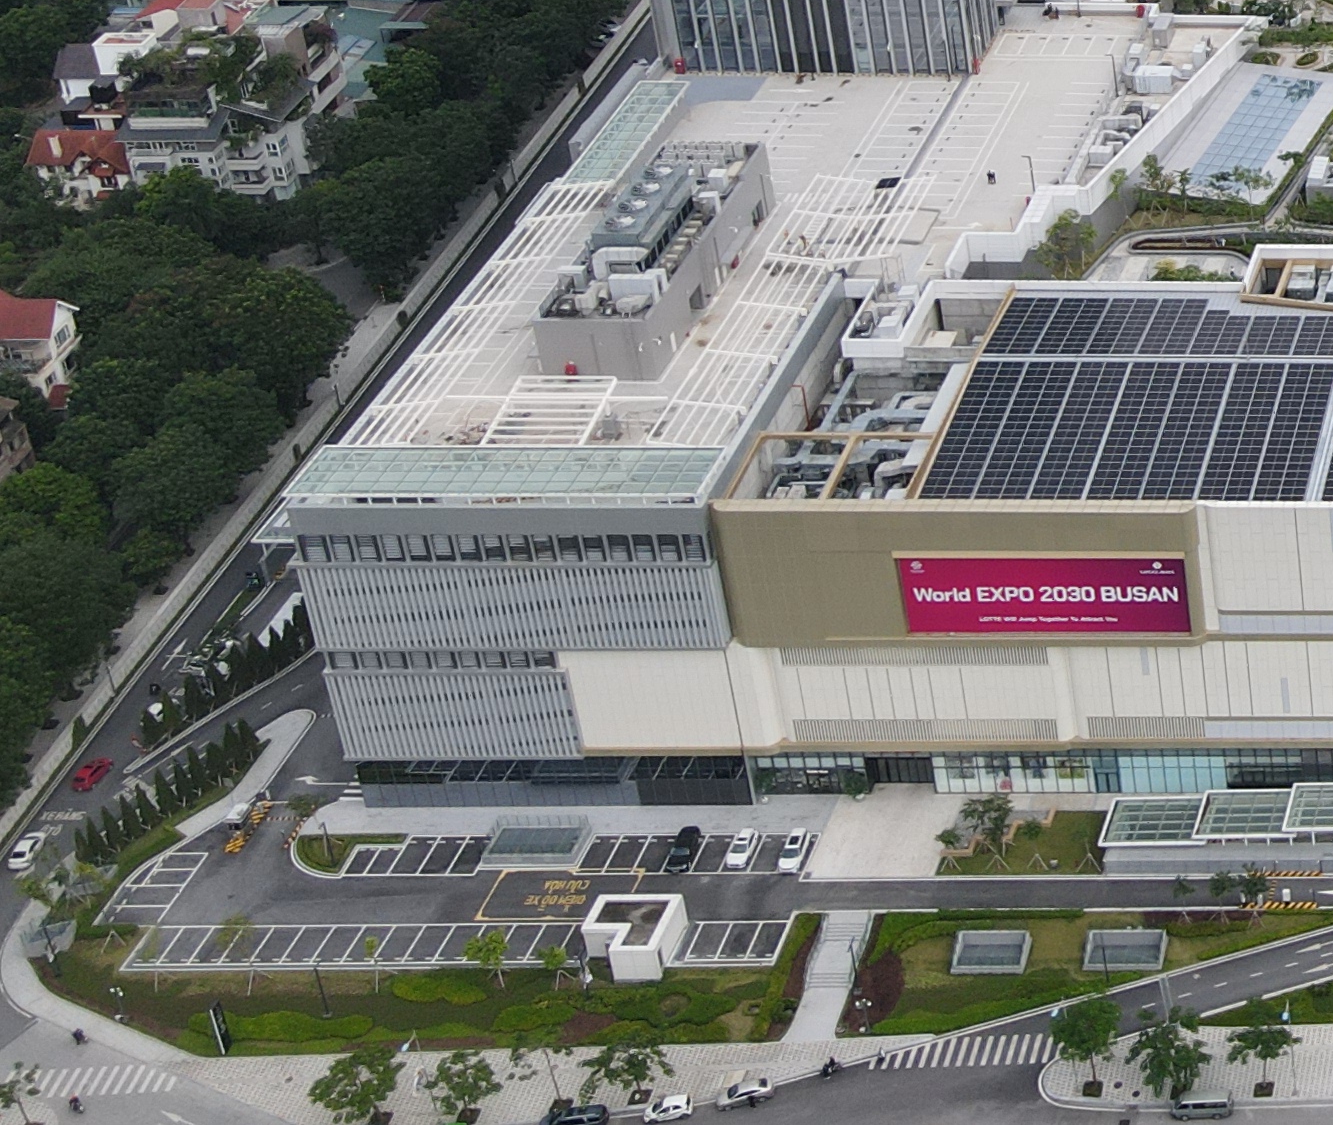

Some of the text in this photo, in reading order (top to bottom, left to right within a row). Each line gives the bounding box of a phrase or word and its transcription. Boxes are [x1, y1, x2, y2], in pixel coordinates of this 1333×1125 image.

[912, 586, 1179, 603] World EXPO 2030 BUSAN
